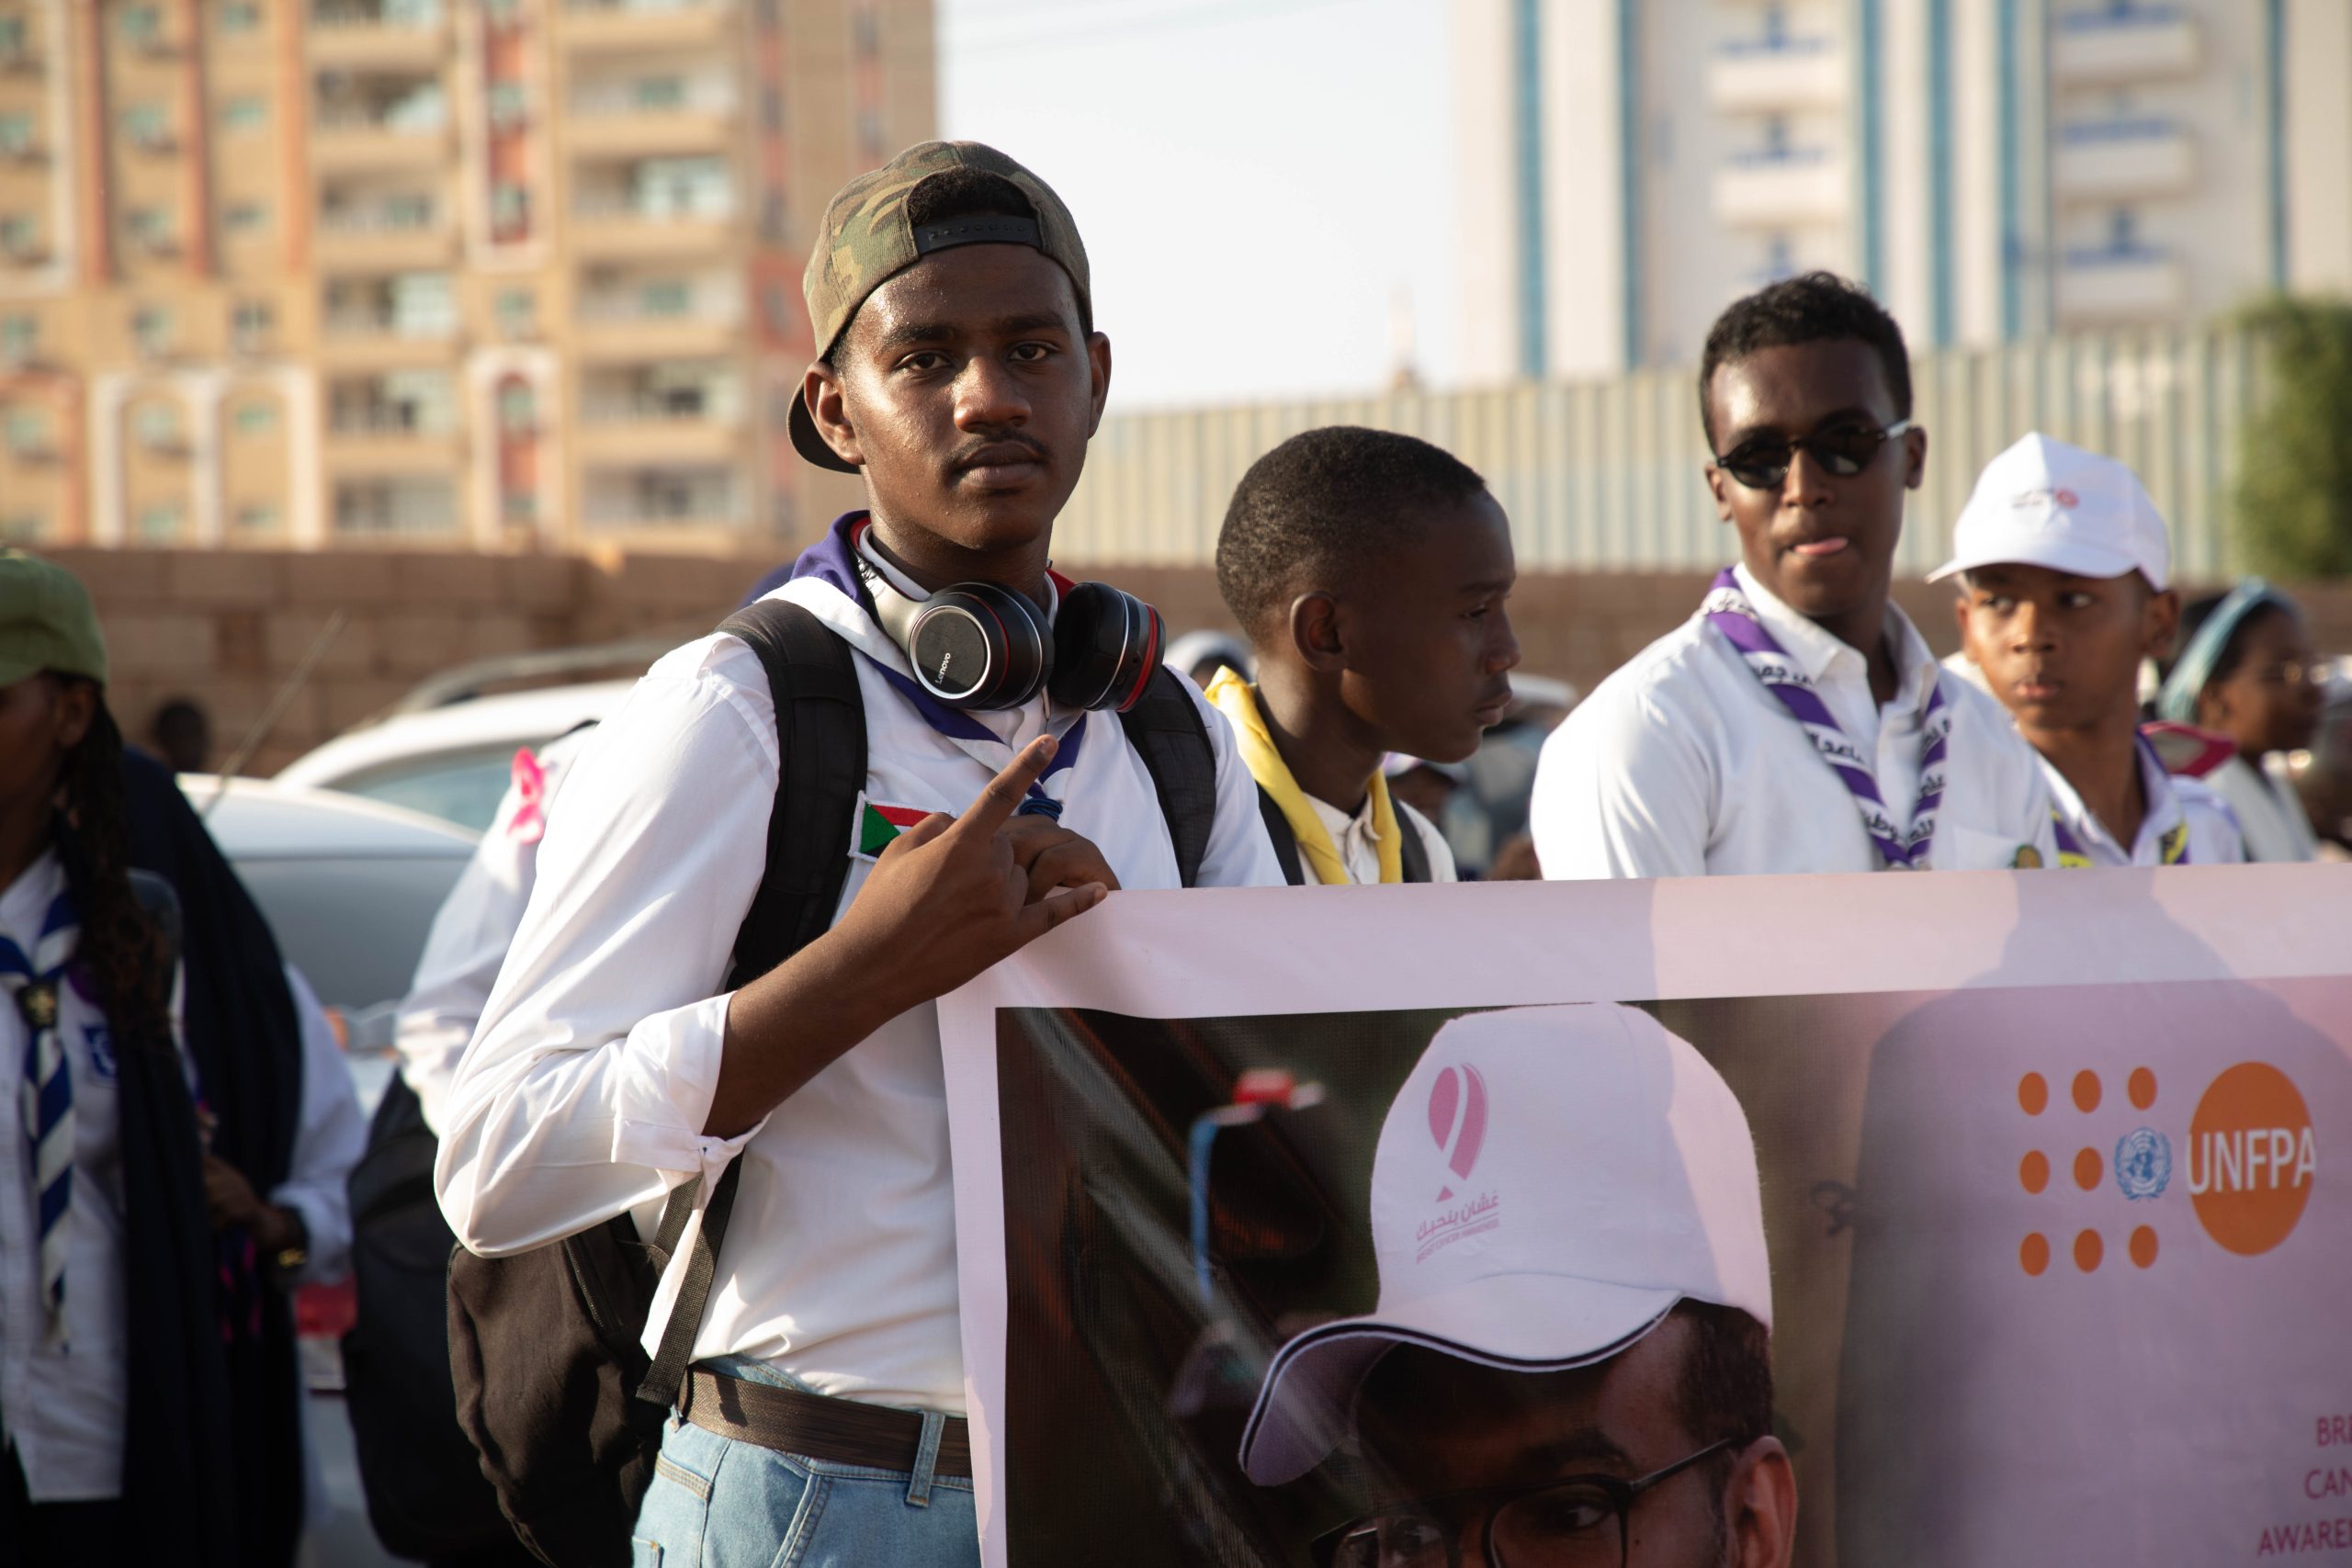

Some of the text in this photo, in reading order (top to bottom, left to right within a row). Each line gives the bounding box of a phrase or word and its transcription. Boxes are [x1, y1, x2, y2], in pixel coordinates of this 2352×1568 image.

[934, 652, 951, 685] Lenovo
[2186, 1126, 2316, 1195] UNFPA
[2256, 1518, 2352, 1557] AWARE
